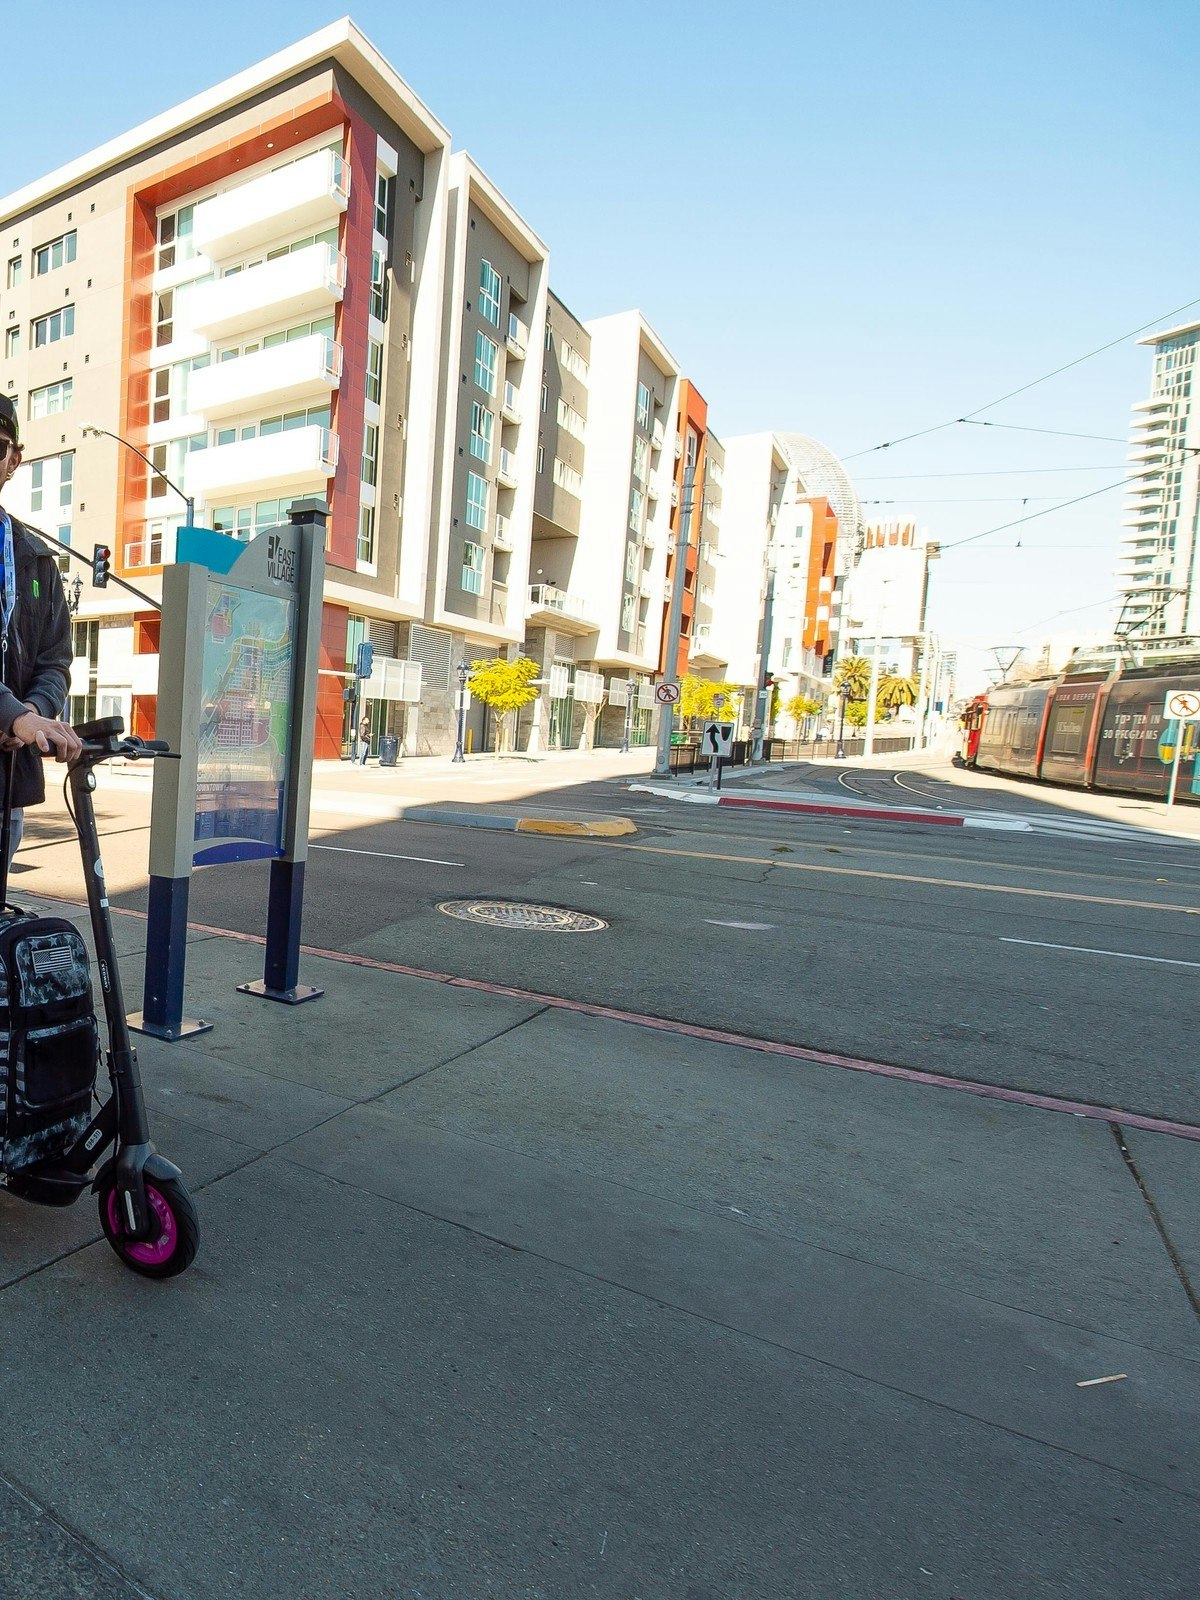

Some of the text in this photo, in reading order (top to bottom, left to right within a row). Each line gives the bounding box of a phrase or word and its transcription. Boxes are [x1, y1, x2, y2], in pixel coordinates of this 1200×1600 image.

[278, 547, 296, 566] EAST
[267, 561, 295, 583] VILLAGE
[1072, 693, 1096, 701] DEEPER
[1115, 715, 1161, 724] TOP TEN IN
[1103, 729, 1114, 738] 30
